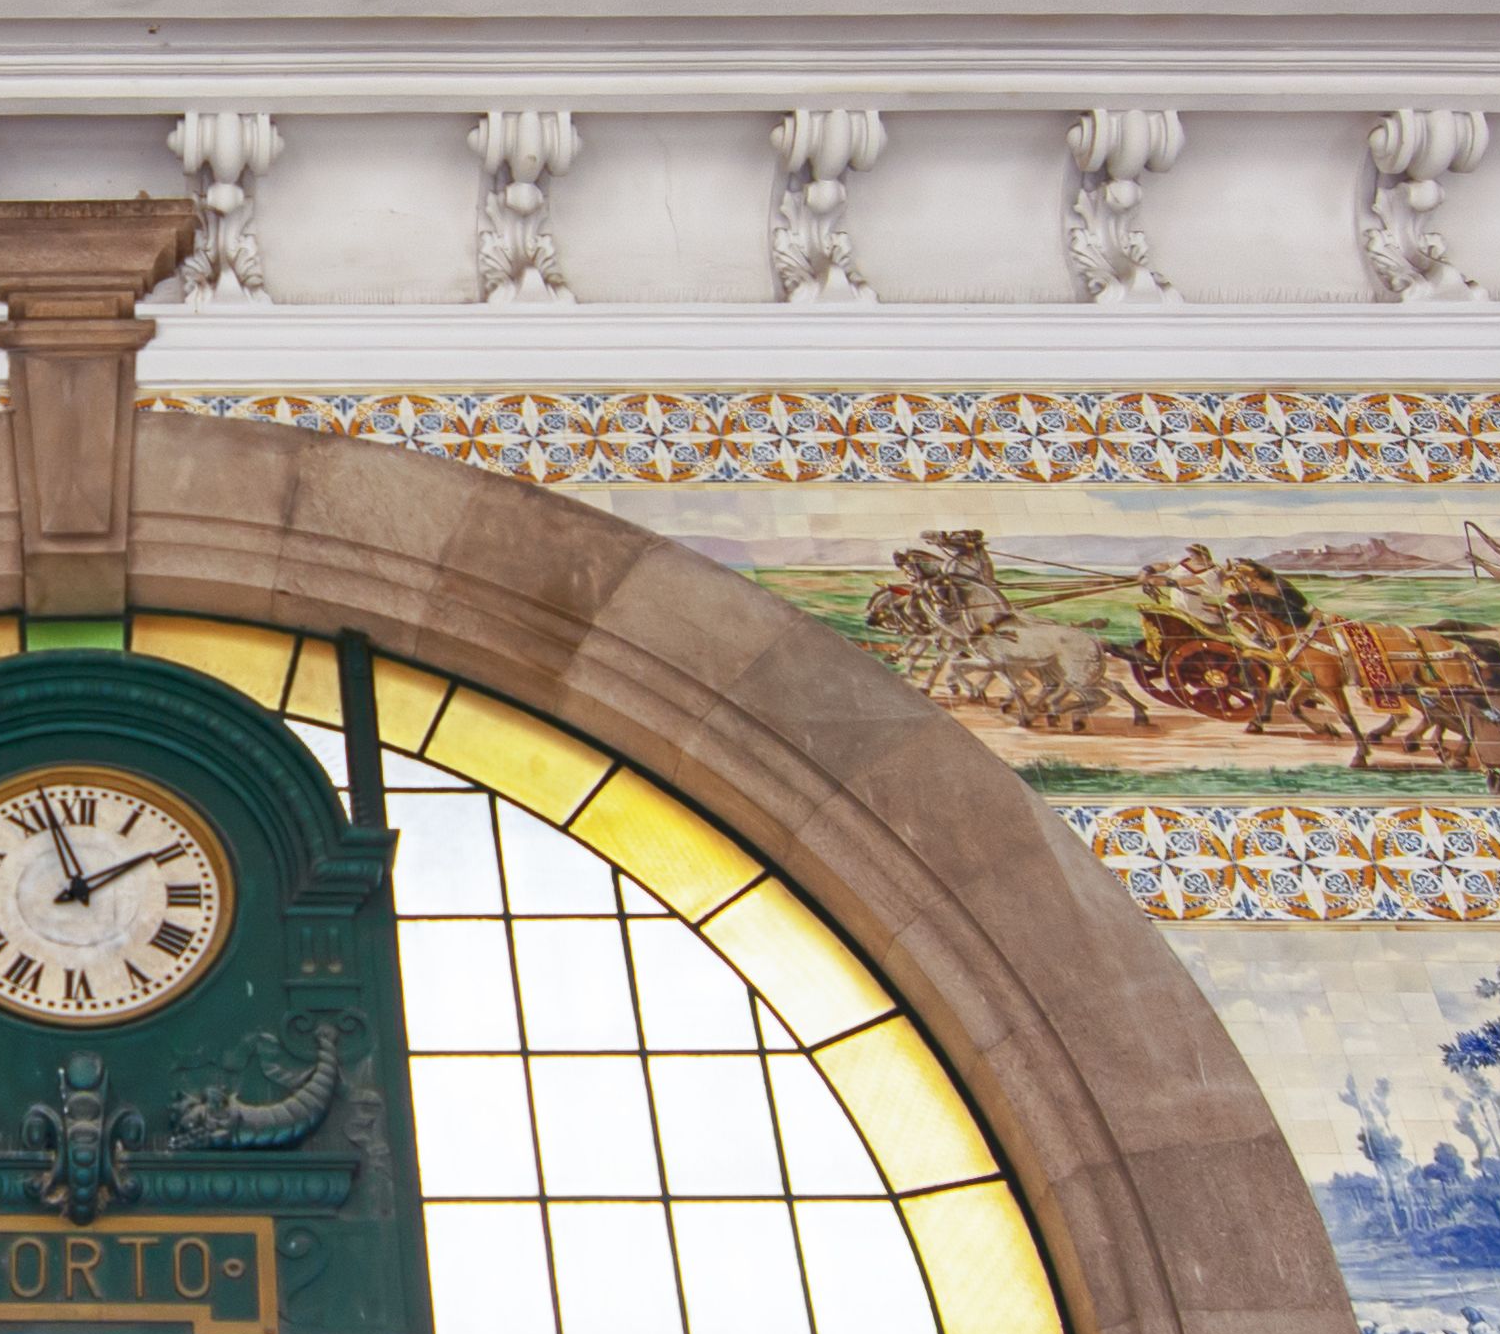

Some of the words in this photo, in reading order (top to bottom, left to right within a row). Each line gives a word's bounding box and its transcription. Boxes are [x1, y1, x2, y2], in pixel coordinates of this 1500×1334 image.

[5, 805, 48, 839] XI
[59, 798, 98, 827] XII
[118, 810, 142, 837] I
[151, 841, 188, 867] II
[166, 884, 202, 909] III
[148, 920, 197, 960] IIII
[2, 952, 45, 994] VII
[64, 969, 95, 1000] VI
[123, 959, 152, 990] V
